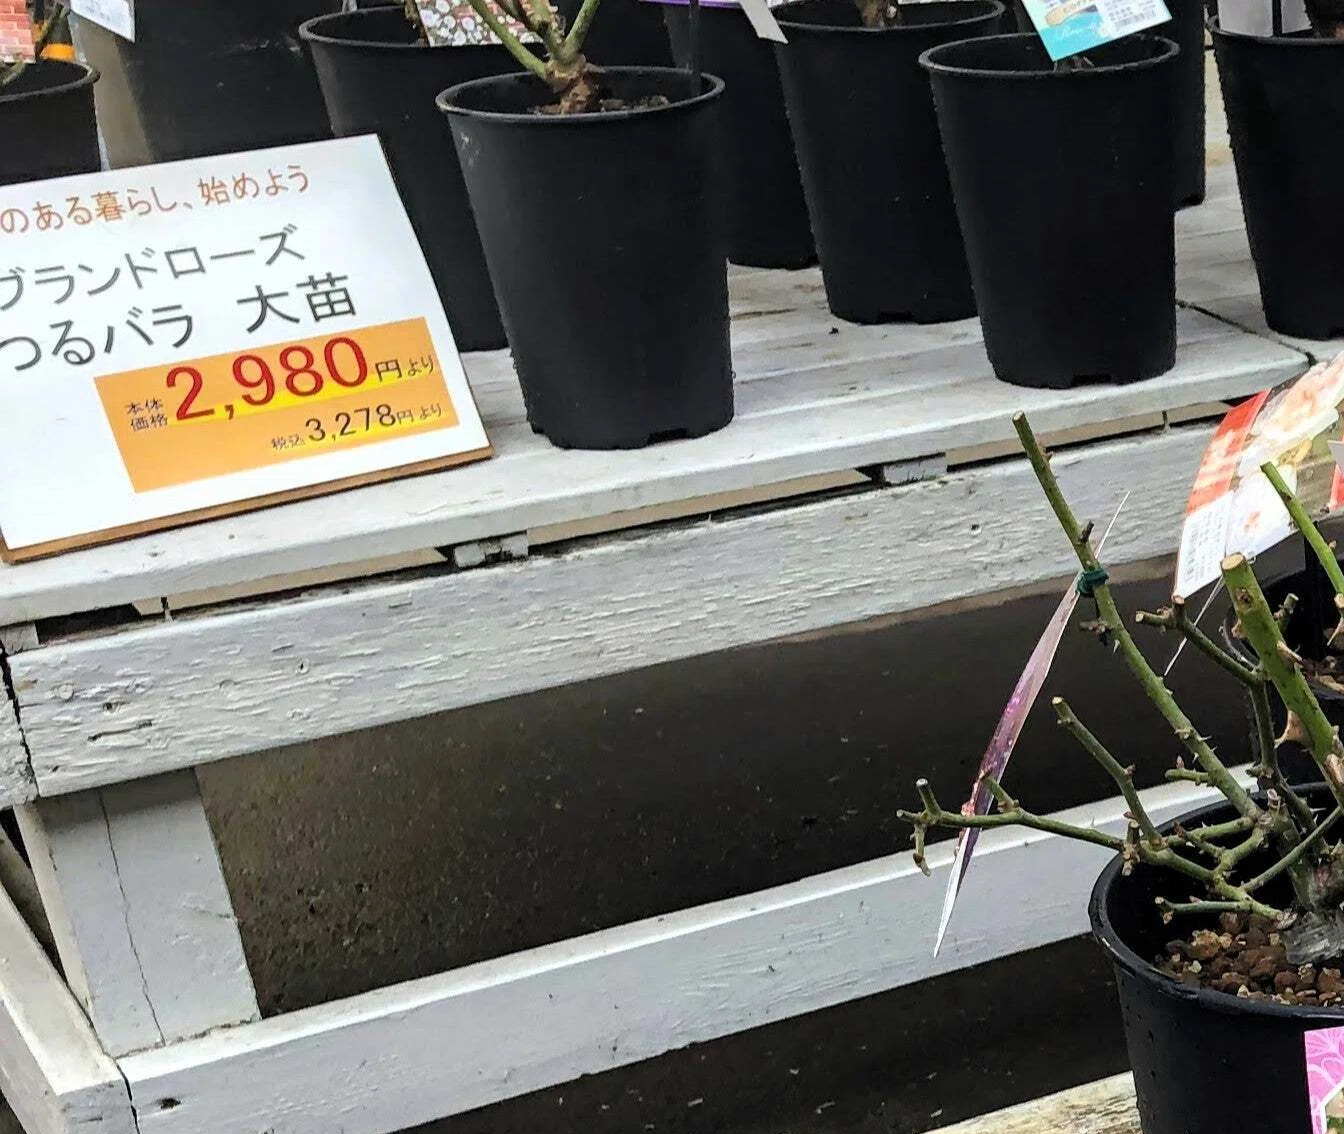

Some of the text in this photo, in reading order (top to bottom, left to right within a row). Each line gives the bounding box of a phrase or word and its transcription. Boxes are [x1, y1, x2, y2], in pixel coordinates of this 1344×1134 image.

[0, 223, 305, 311] ブランドローズ
[236, 272, 357, 333] 大苗
